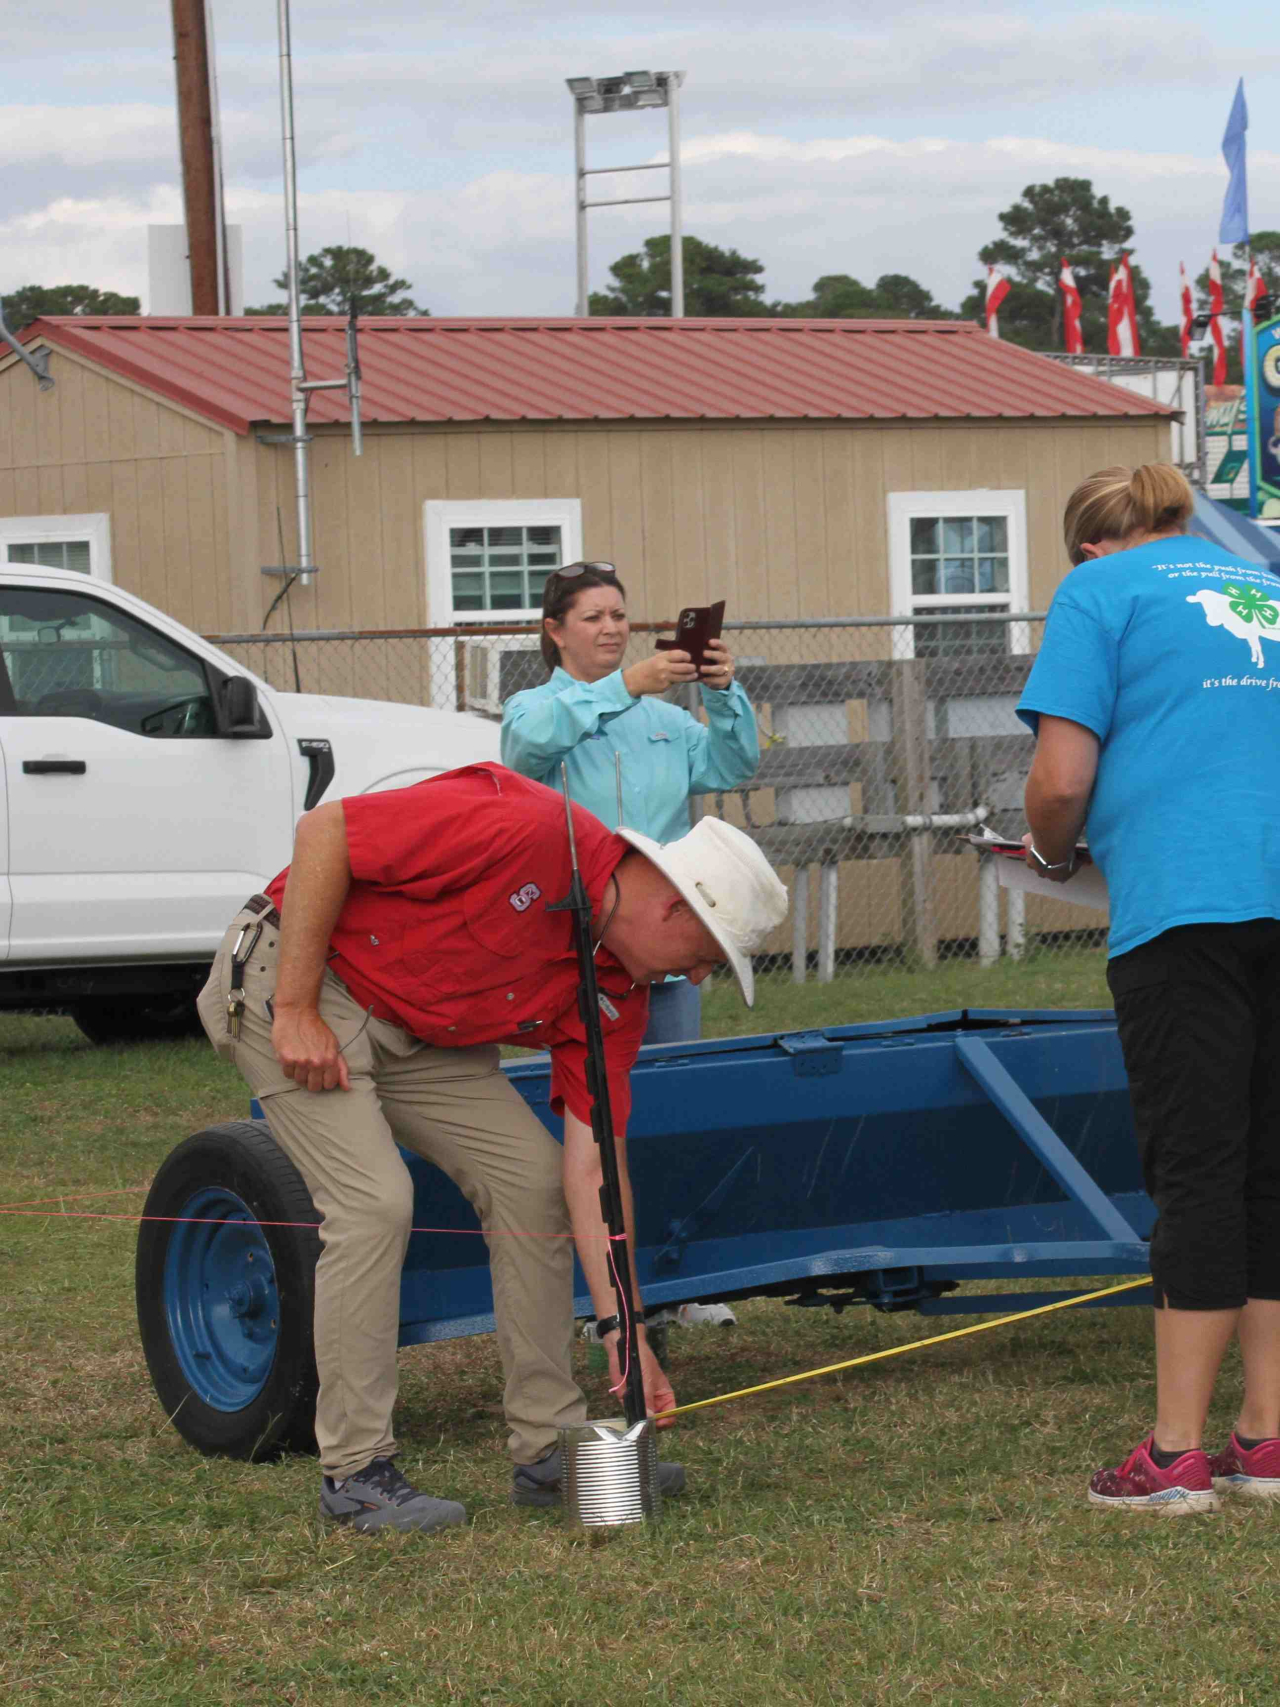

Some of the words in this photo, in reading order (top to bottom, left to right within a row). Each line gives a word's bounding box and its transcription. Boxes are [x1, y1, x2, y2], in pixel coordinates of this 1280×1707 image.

[1203, 678, 1219, 688] it's
[1222, 675, 1238, 686] the
[1240, 675, 1267, 687] drive
